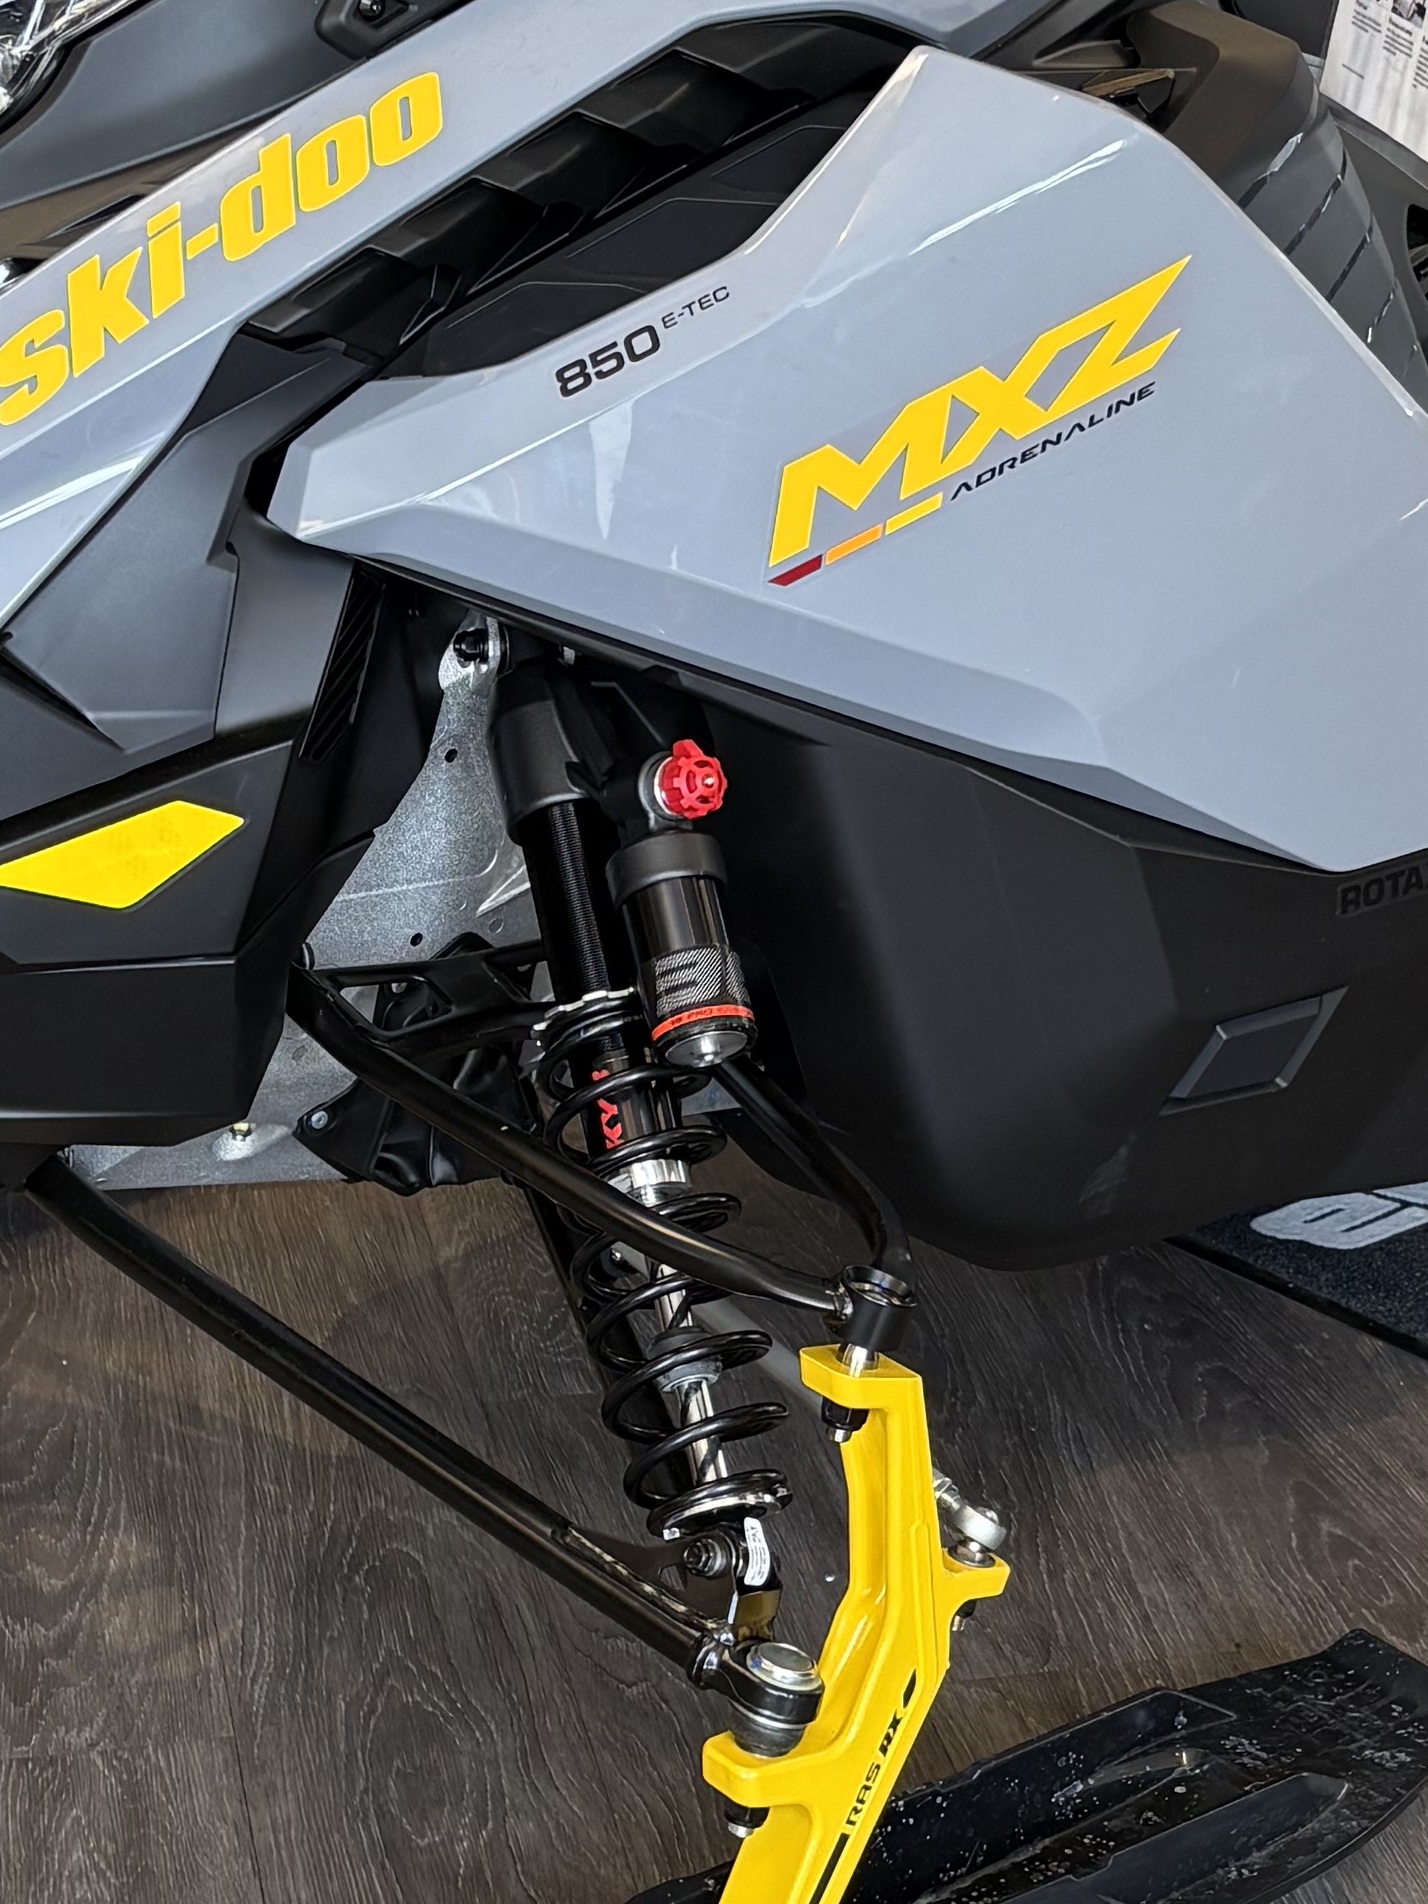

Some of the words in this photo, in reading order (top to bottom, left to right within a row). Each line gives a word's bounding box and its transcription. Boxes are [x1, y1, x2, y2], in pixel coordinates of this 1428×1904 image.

[554, 324, 661, 399] 850
[660, 285, 731, 330] E-TEC
[768, 254, 1192, 568] MXZ
[950, 380, 1157, 502] ADRENALINE
[845, 1761, 882, 1827] RAS
[878, 1708, 904, 1758] RX
